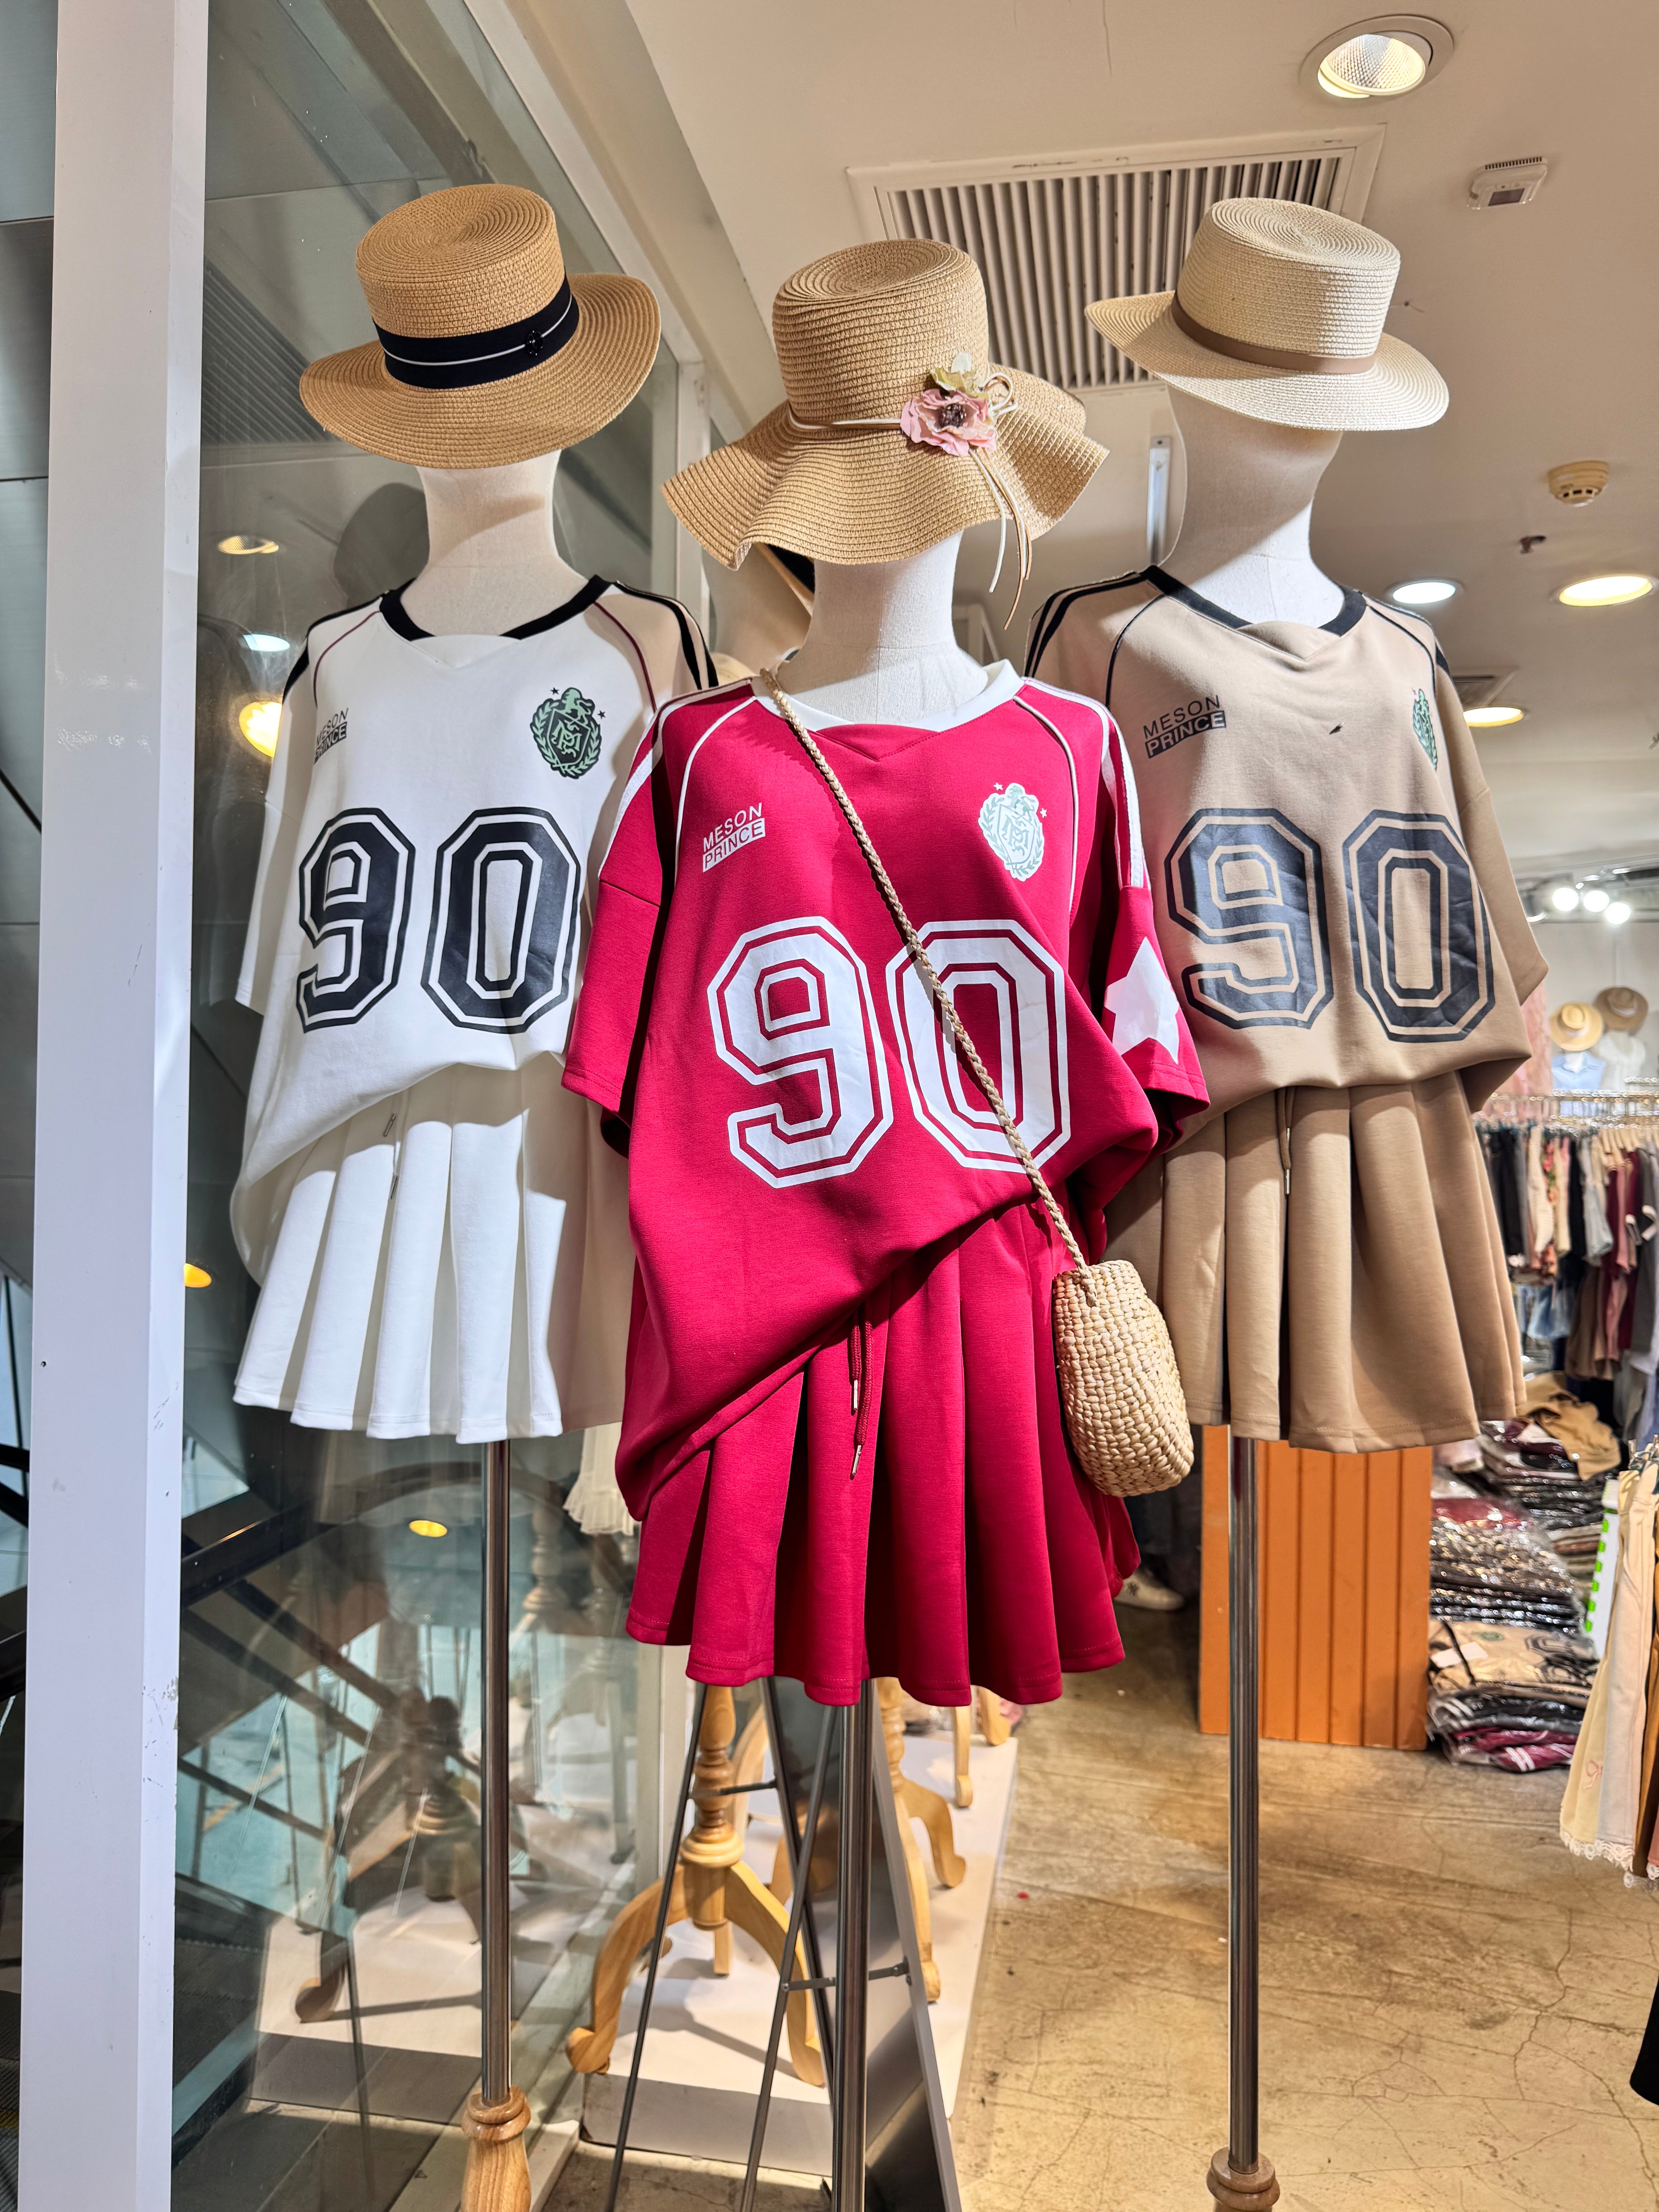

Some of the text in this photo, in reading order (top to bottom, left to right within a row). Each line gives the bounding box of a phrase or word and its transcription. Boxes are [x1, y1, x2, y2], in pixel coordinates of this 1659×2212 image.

[314, 722, 347, 761] PRINCE
[316, 707, 349, 746] MESON
[1143, 695, 1220, 739] MESON
[1146, 711, 1225, 757] PRINCE
[703, 802, 762, 852] MESON
[704, 820, 763, 869] PRINCE
[296, 806, 581, 1034] 90
[1164, 808, 1496, 1043] 90
[707, 916, 1071, 1188] 90
